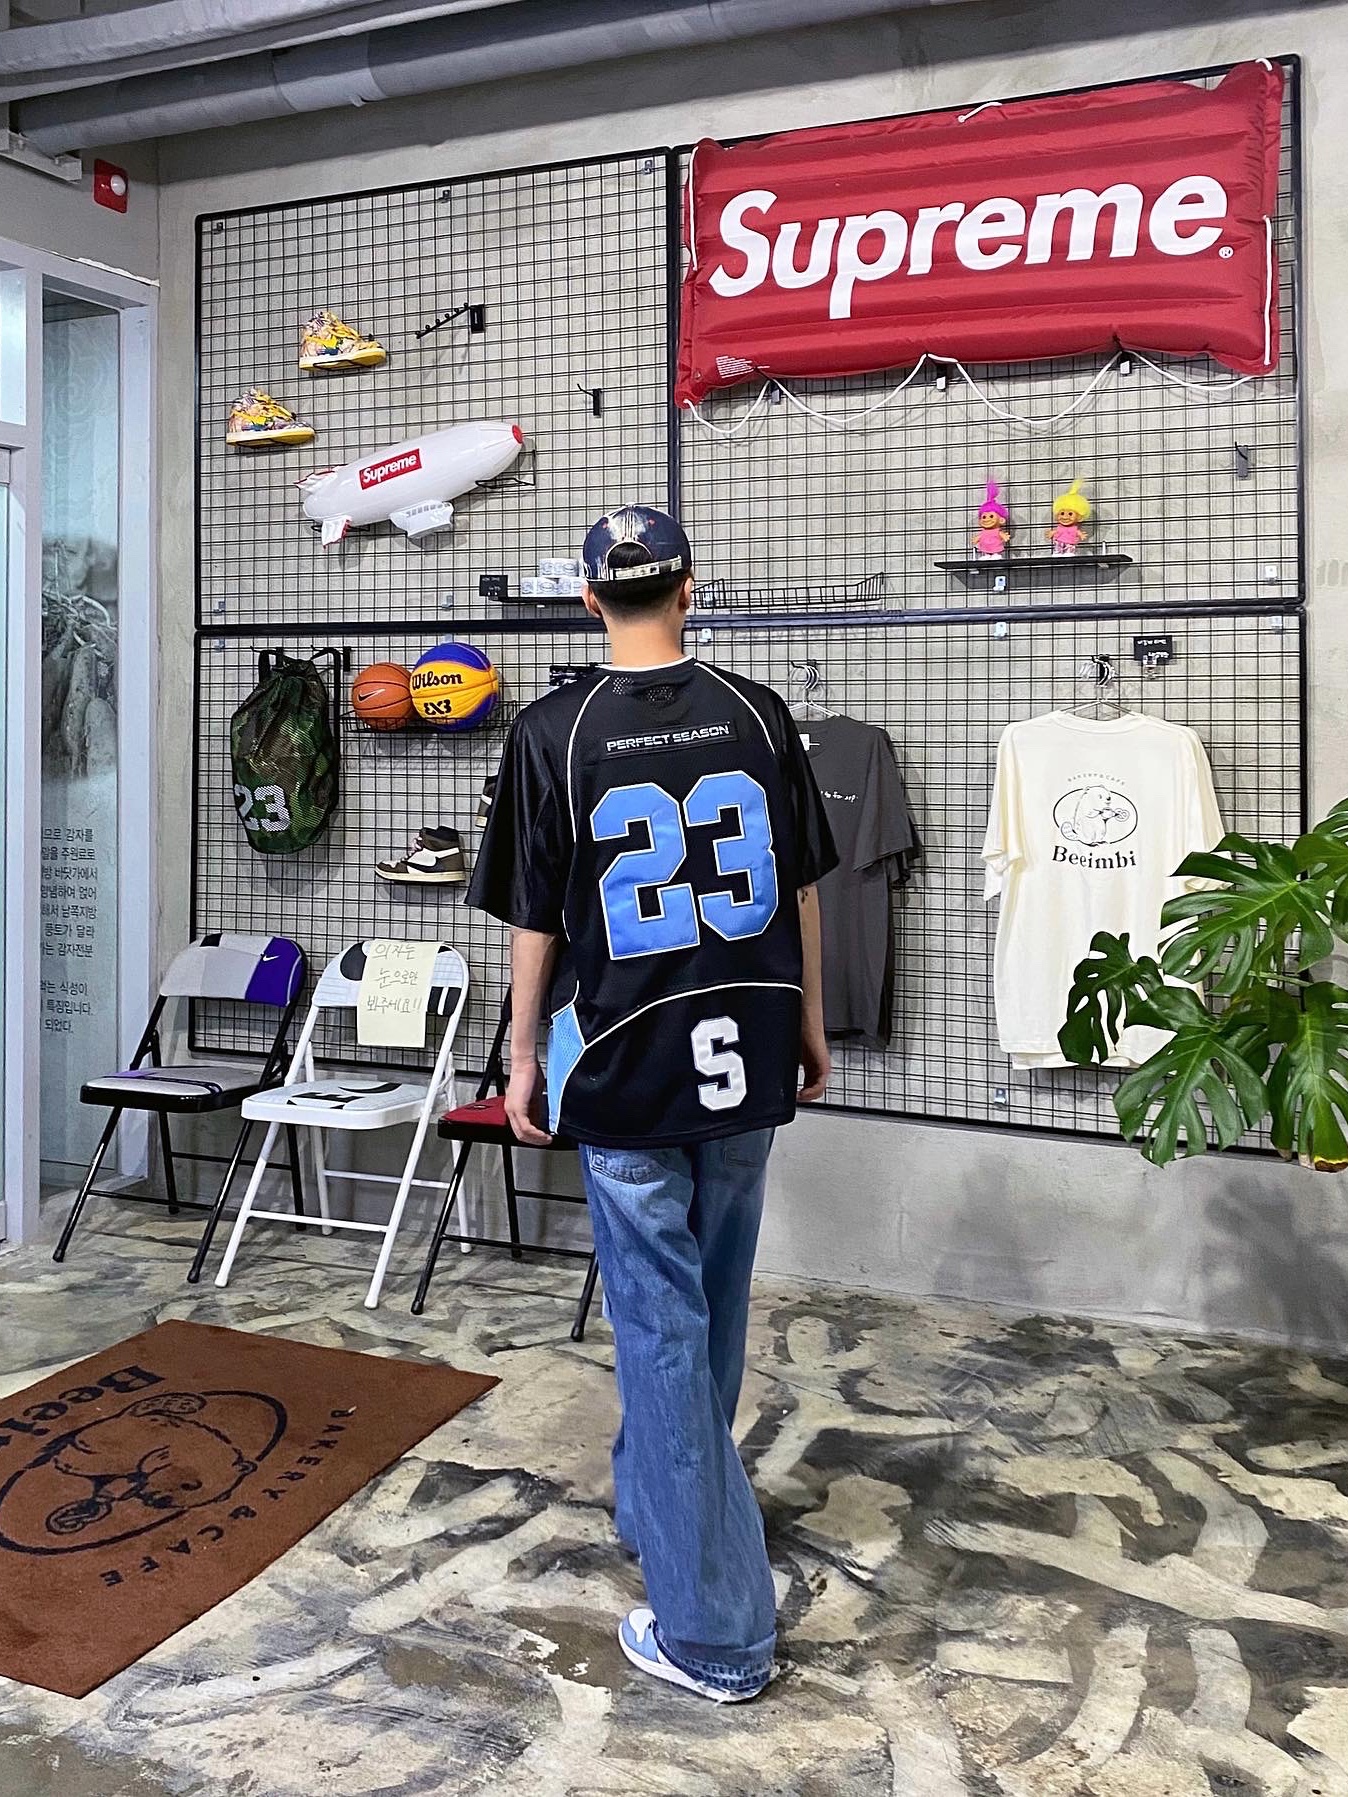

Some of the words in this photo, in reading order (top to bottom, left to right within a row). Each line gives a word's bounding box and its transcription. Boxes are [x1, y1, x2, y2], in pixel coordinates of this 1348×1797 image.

[708, 175, 1227, 320] Supreme
[362, 454, 417, 483] Supreme
[411, 671, 464, 690] Wilson
[606, 733, 670, 752] PERFECT
[673, 724, 730, 743] SEASON
[234, 783, 291, 832] 23
[590, 770, 778, 961] 23
[1052, 845, 1137, 869] Beeimbi
[372, 943, 416, 960] 의자는
[373, 968, 419, 989] 눈으로만
[690, 1015, 747, 1112] S
[0, 1364, 165, 1446] Beei
